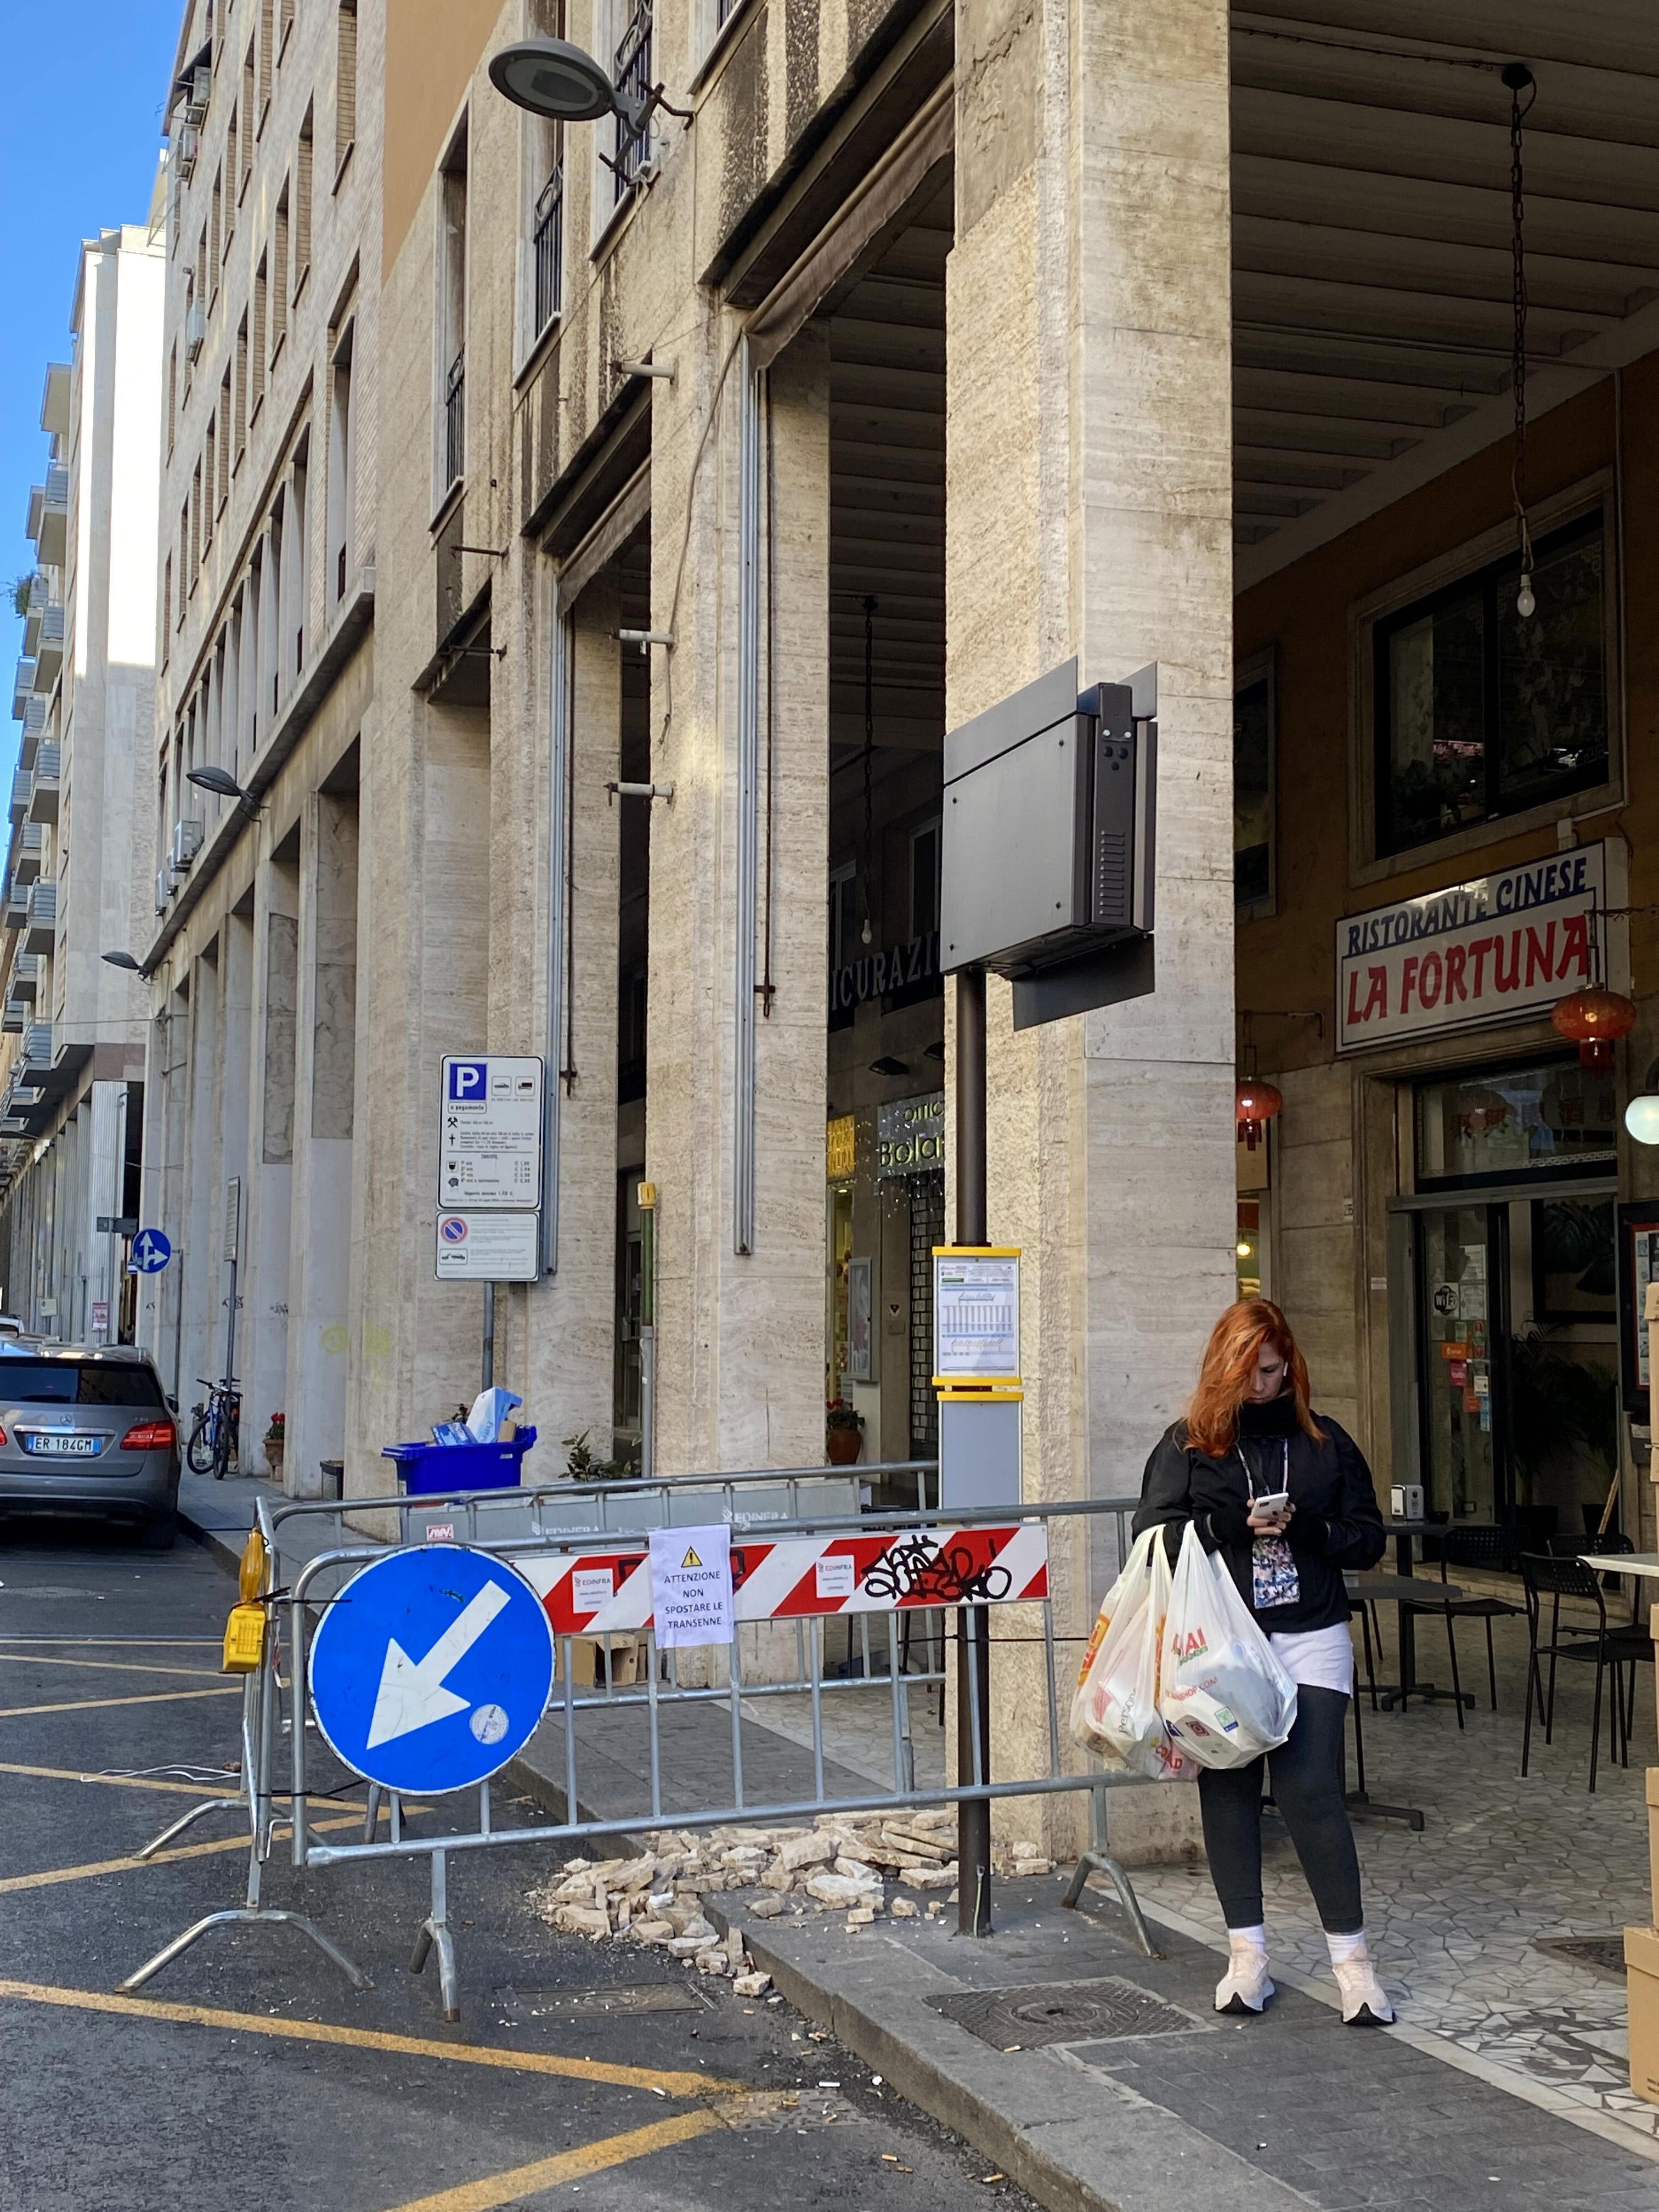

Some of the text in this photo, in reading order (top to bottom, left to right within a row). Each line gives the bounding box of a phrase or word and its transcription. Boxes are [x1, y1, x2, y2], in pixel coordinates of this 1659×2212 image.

[1348, 856, 1587, 956] RISTORANTE CINESE
[831, 930, 940, 1011] ICURAZI
[1347, 914, 1590, 1025] LA FORTUNA
[456, 1066, 480, 1097] P
[35, 1437, 92, 1451] ER 184GM
[664, 1571, 721, 1584] ATTENZIONE
[682, 1588, 704, 1598] NON
[665, 1601, 723, 1614] SPOSTARE LE
[667, 1617, 723, 1629] TRANSENNE
